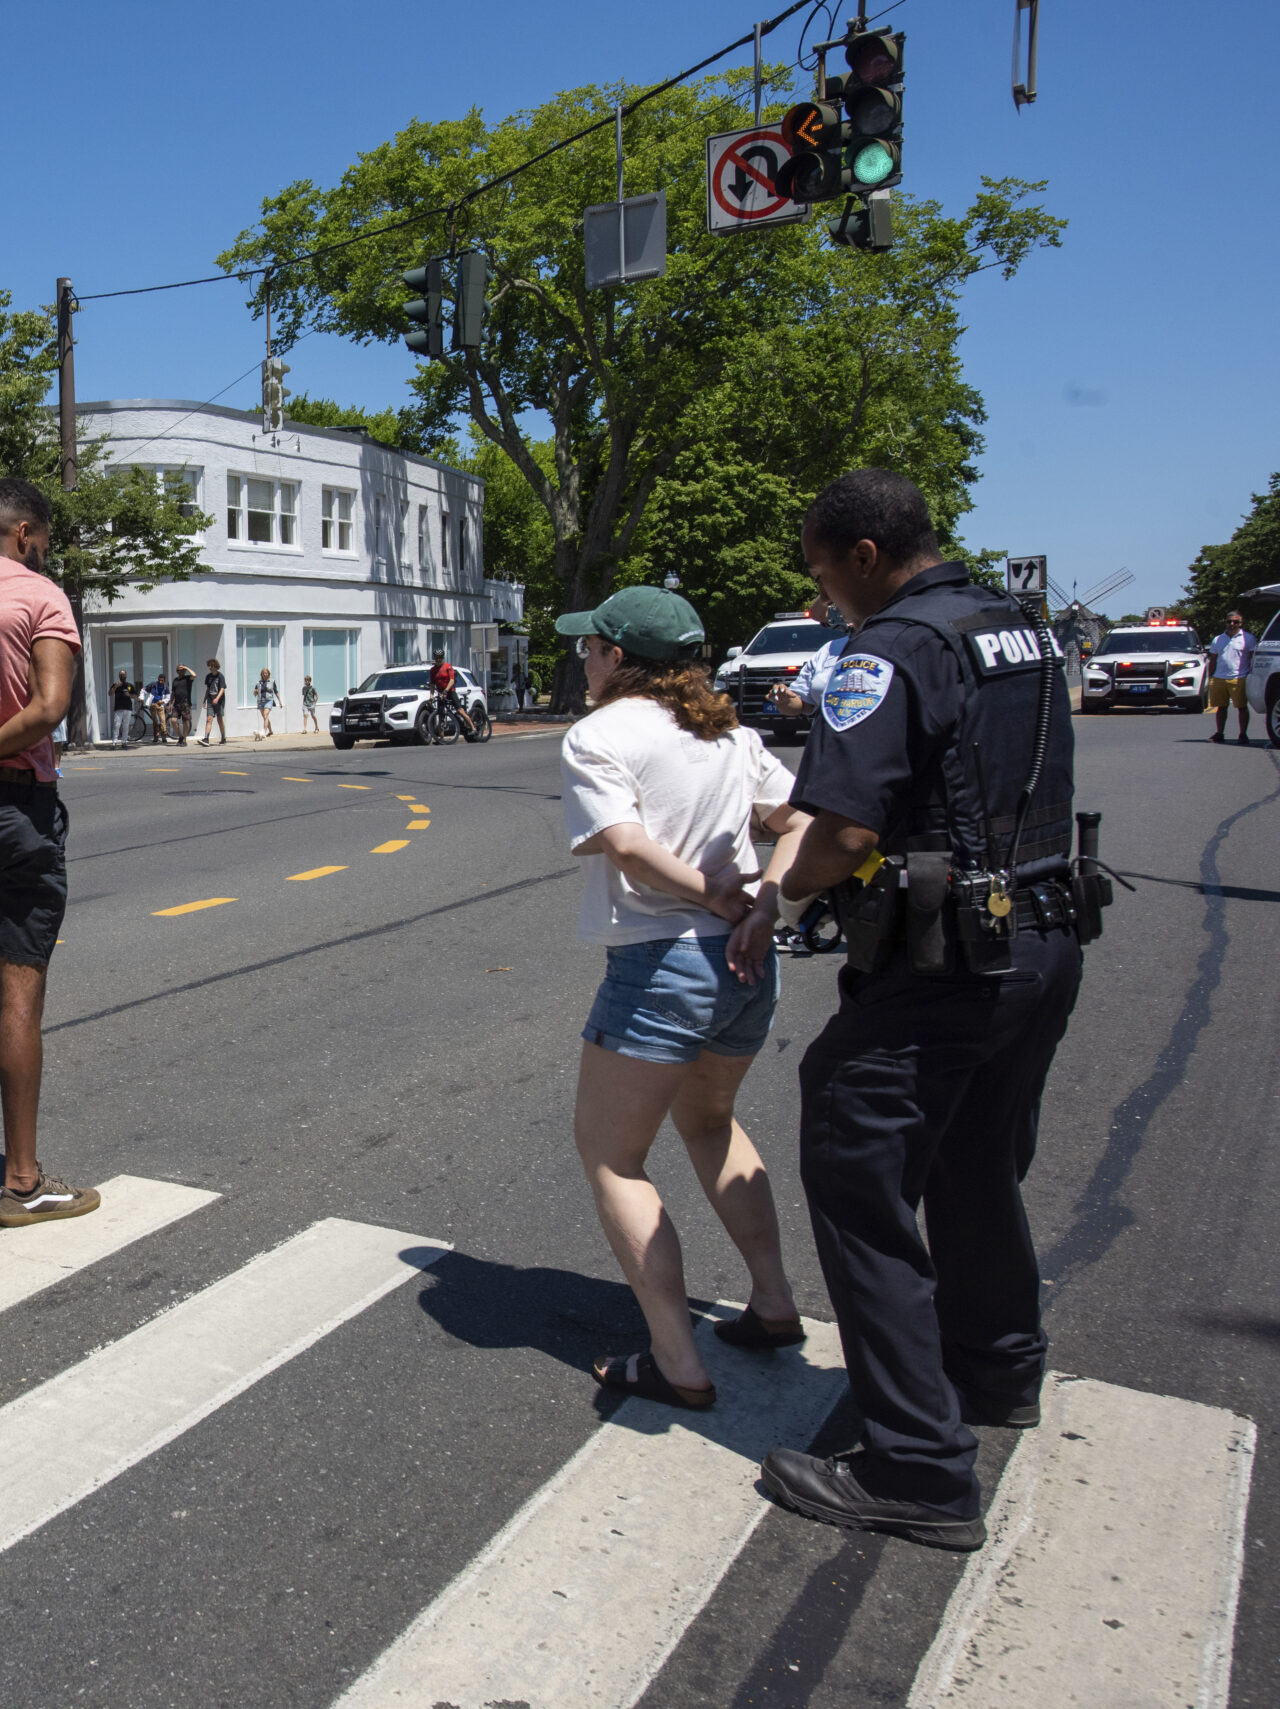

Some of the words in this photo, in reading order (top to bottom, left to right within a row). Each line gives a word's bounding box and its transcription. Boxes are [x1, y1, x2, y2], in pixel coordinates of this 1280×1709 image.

[974, 628, 1064, 668] POLI
[842, 660, 877, 671] POLICE
[840, 697, 875, 707] HARBOR
